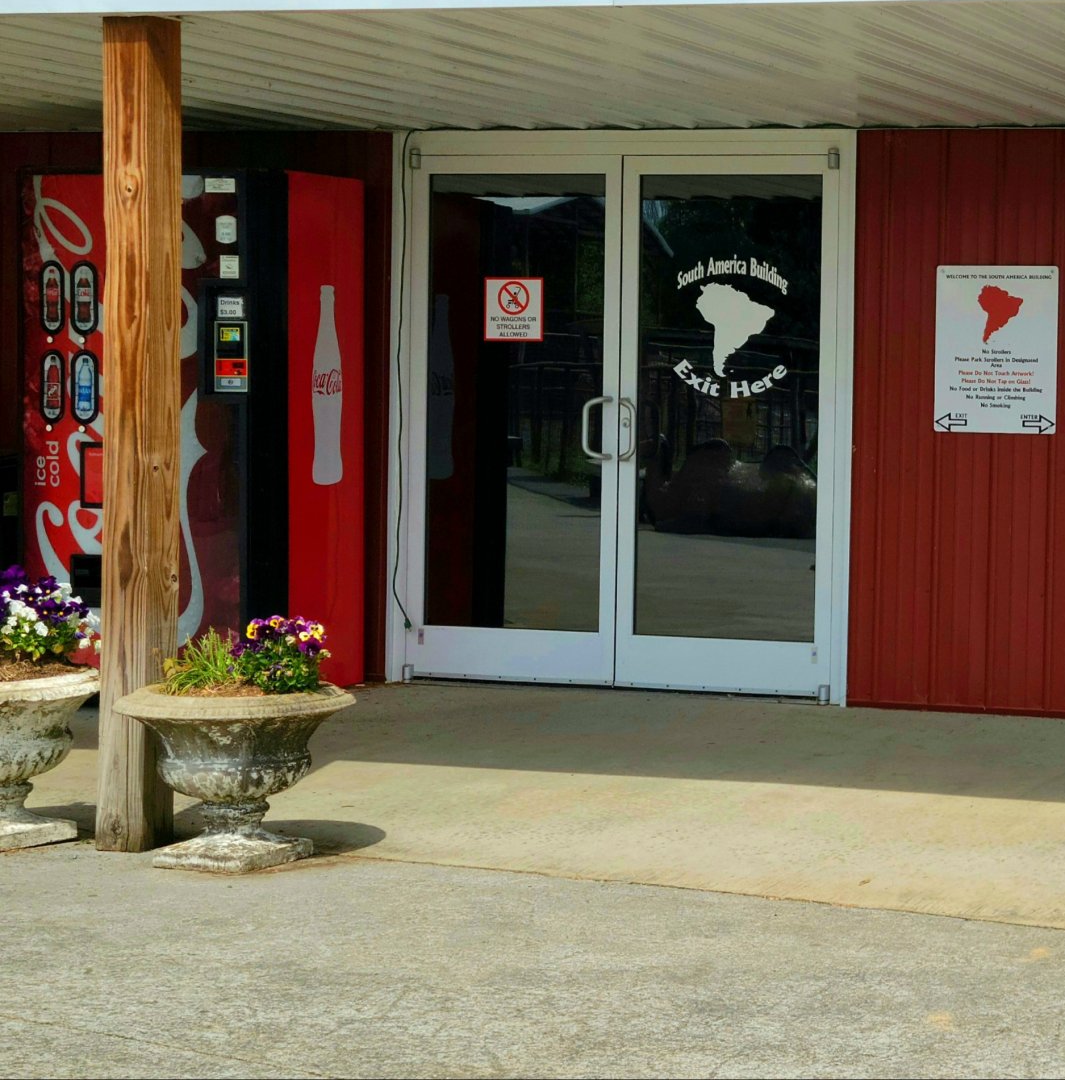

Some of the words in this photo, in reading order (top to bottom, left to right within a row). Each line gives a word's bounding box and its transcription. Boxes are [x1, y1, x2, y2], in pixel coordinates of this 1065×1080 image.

[677, 260, 704, 290] South
[706, 254, 746, 276] America
[750, 257, 788, 296] Building
[672, 358, 720, 397] Exit
[730, 364, 788, 398] Here
[34, 456, 46, 486] ice
[46, 441, 60, 487] cold
